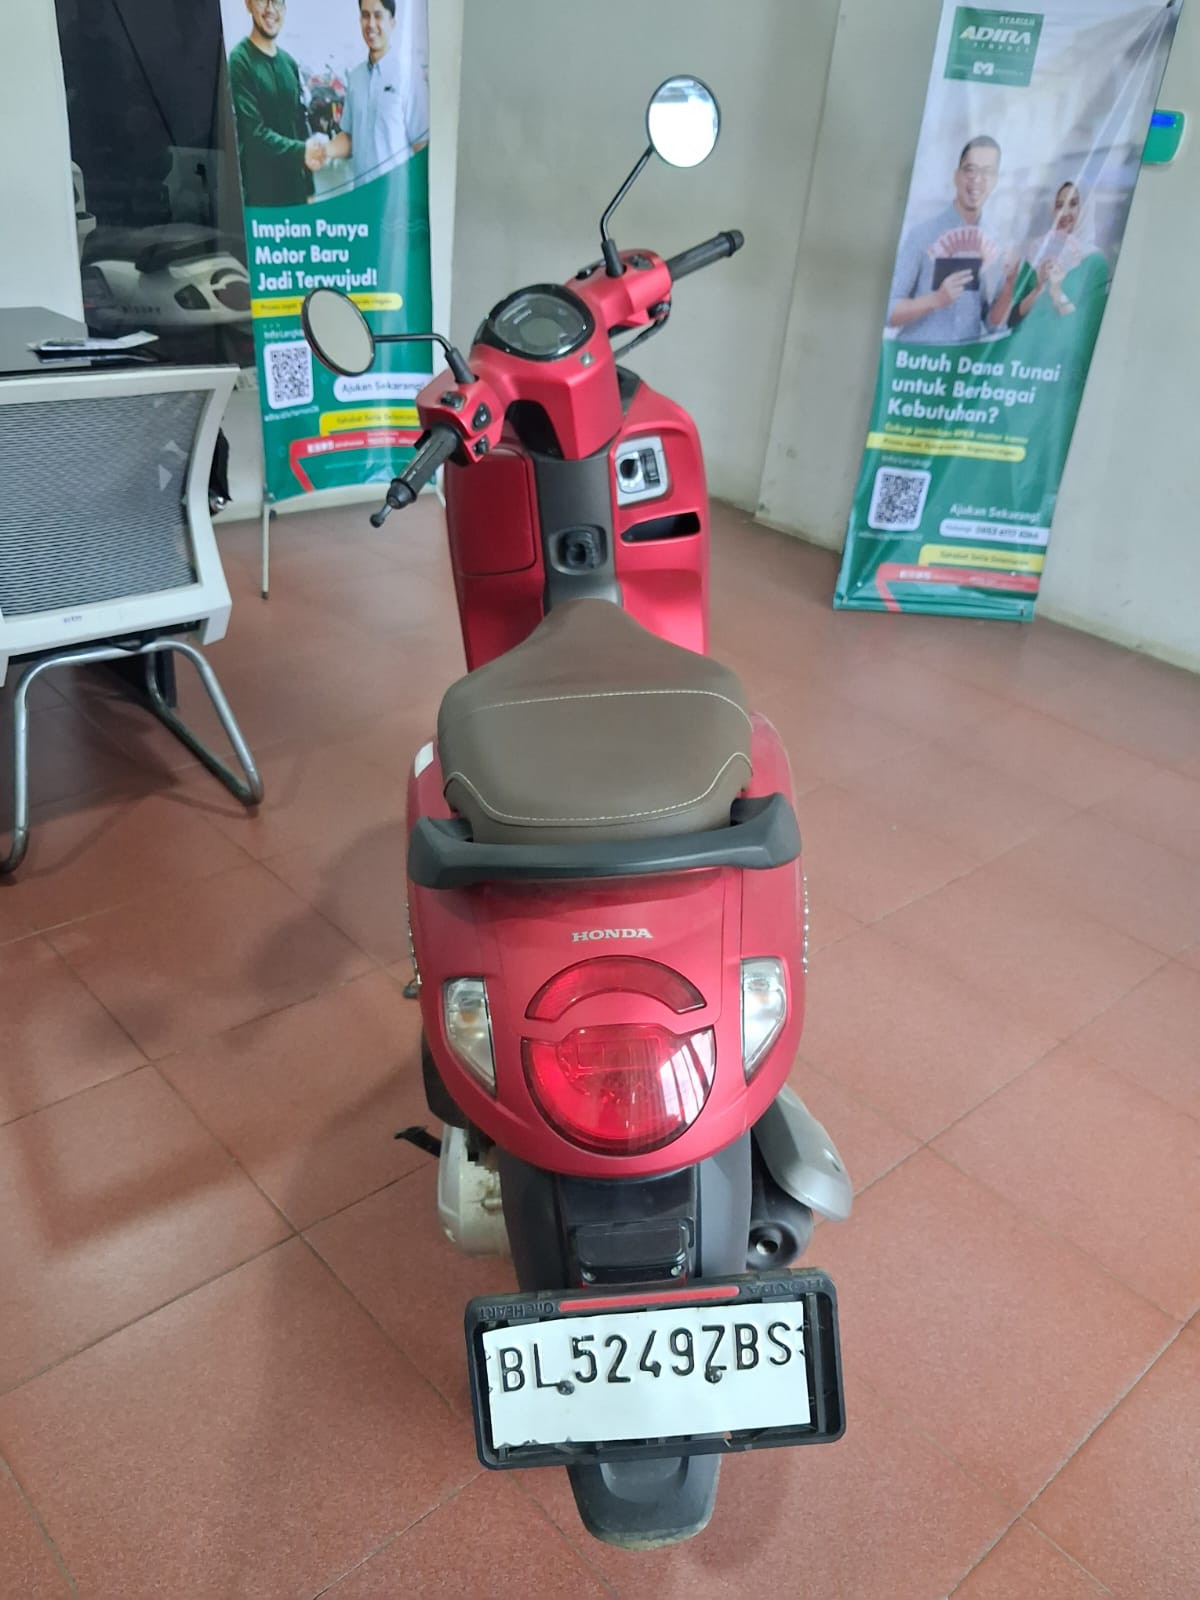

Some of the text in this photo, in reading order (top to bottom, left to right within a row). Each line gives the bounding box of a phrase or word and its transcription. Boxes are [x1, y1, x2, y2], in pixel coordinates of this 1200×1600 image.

[960, 25, 1031, 45] ADIRA
[251, 218, 369, 243] Impian Punya
[255, 244, 349, 265] Motor Baru
[257, 267, 377, 291] Jadi Terwujud!
[895, 350, 1061, 382] Butuh Dana Tunai
[892, 377, 1037, 407] untuk Berbagai
[887, 398, 999, 424] Kebutuhan?
[950, 503, 986, 517] Ajukan
[571, 928, 653, 942] HONDA
